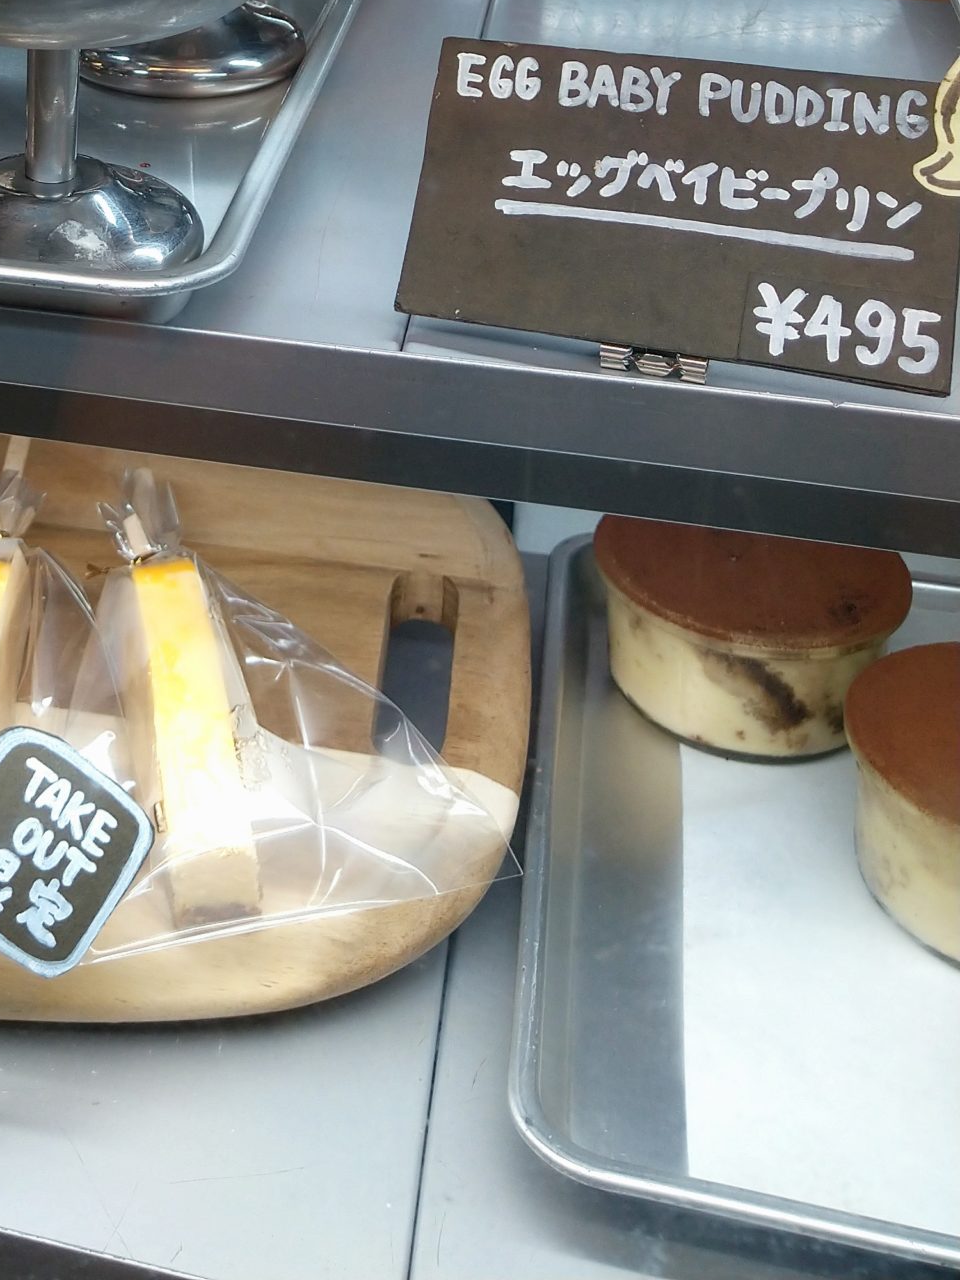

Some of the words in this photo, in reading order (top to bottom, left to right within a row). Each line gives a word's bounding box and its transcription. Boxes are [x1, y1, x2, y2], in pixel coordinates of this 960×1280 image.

[456, 52, 542, 102] EGG
[557, 60, 682, 116] BABY
[697, 71, 930, 140] PUDDING
[501, 148, 923, 233] エッグベイビープリン
[752, 281, 942, 375] ¥495
[25, 756, 118, 858] TAKE
[12, 816, 97, 887] OUT
